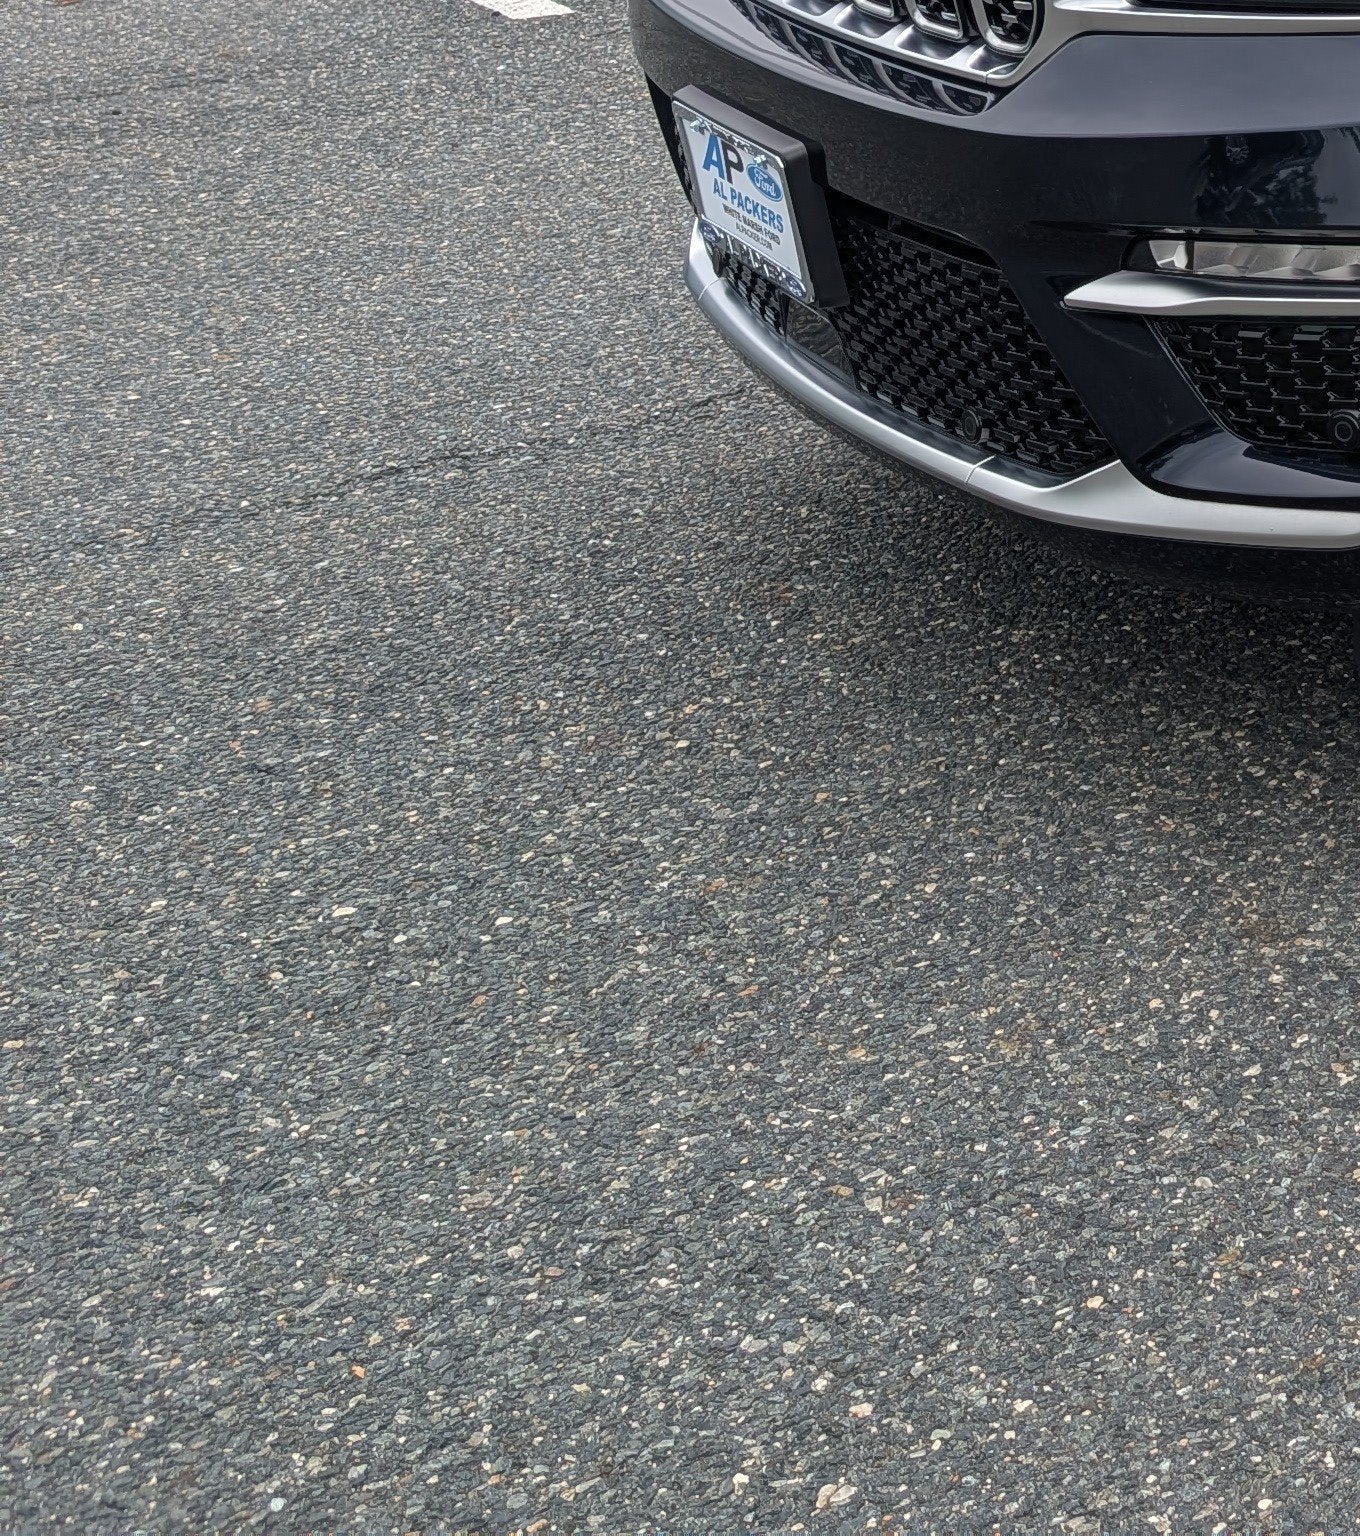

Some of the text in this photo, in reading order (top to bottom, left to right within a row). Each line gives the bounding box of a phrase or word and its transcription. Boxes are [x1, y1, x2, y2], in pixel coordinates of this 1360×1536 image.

[703, 133, 744, 184] AP
[754, 167, 776, 199] Ford
[713, 177, 727, 201] AL
[730, 186, 784, 234] PACKERS
